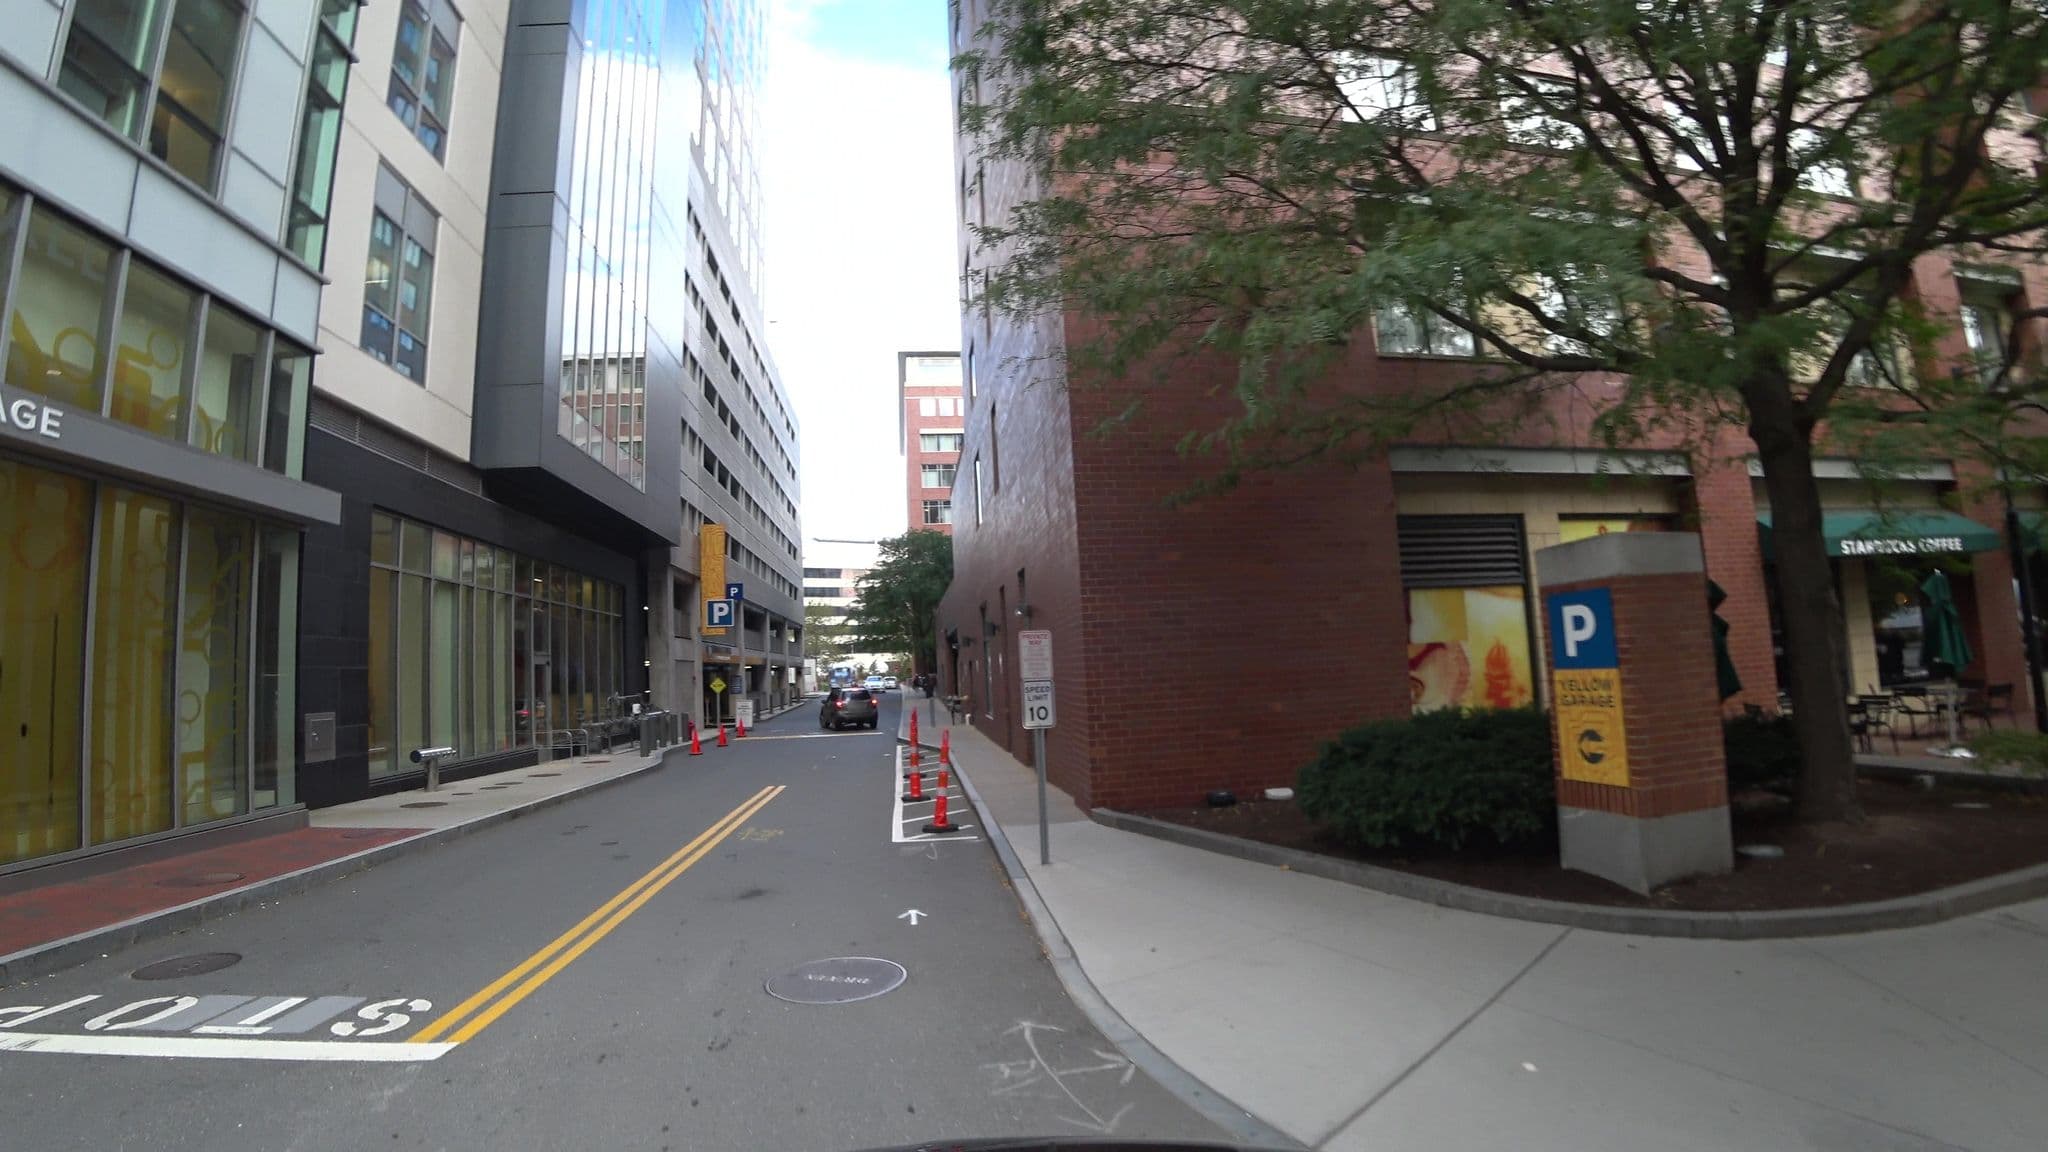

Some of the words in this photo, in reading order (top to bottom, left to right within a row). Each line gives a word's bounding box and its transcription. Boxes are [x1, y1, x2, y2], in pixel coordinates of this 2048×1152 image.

[1840, 539, 1917, 555] STARBUCKS
[1918, 537, 1963, 553] COFFEE
[730, 586, 739, 597] P
[713, 603, 730, 624] P
[1561, 604, 1597, 657] P
[1560, 678, 1613, 692] YELLOW
[1560, 694, 1616, 708] GARAGE
[1029, 706, 1049, 721] 10
